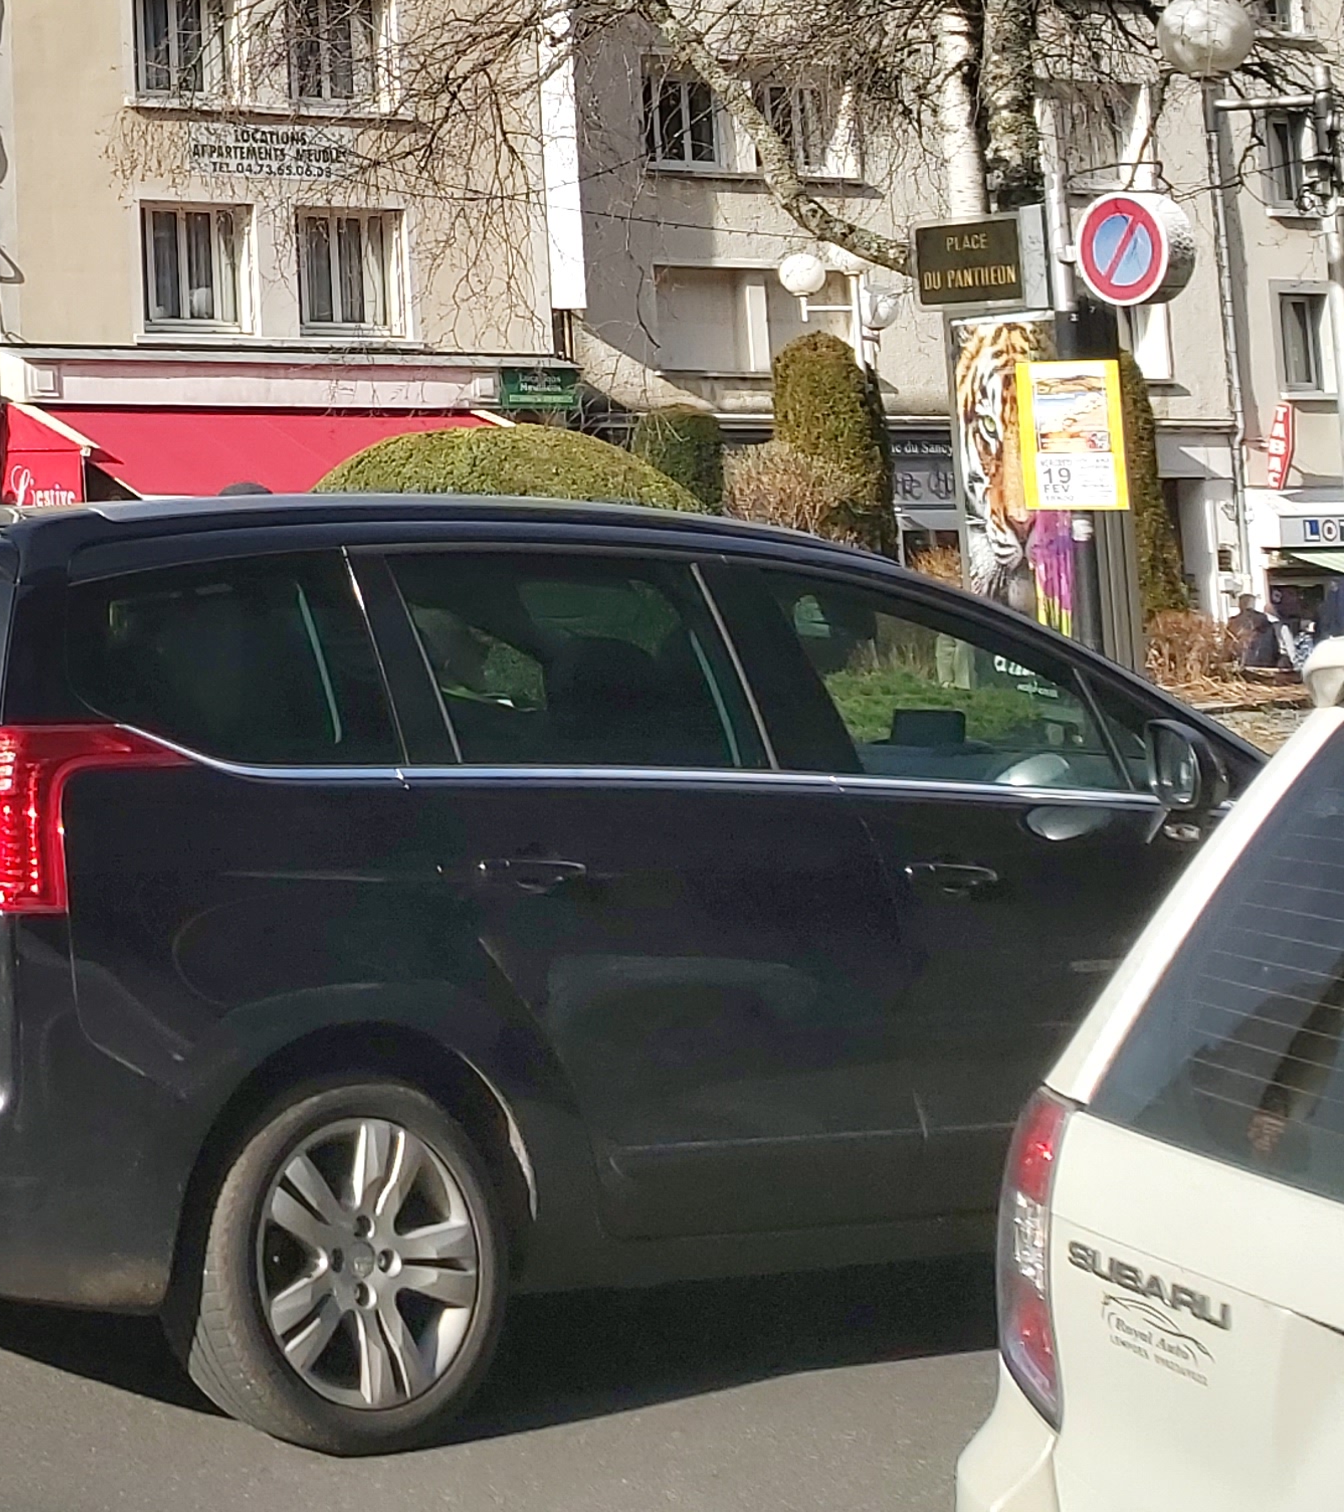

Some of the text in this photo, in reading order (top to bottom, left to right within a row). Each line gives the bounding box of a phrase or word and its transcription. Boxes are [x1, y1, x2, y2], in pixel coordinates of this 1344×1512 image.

[234, 129, 308, 147] LOCATIONS
[192, 143, 286, 162] APPARTEMENTS
[945, 232, 989, 252] PLACE
[923, 264, 1017, 291] DU PANTHEON
[1268, 406, 1287, 488] TABAC
[1043, 467, 1072, 485] 19
[1043, 483, 1070, 494] FEV
[1068, 1240, 1233, 1332] SUBARU
[1115, 1316, 1190, 1361] Royal Auto
